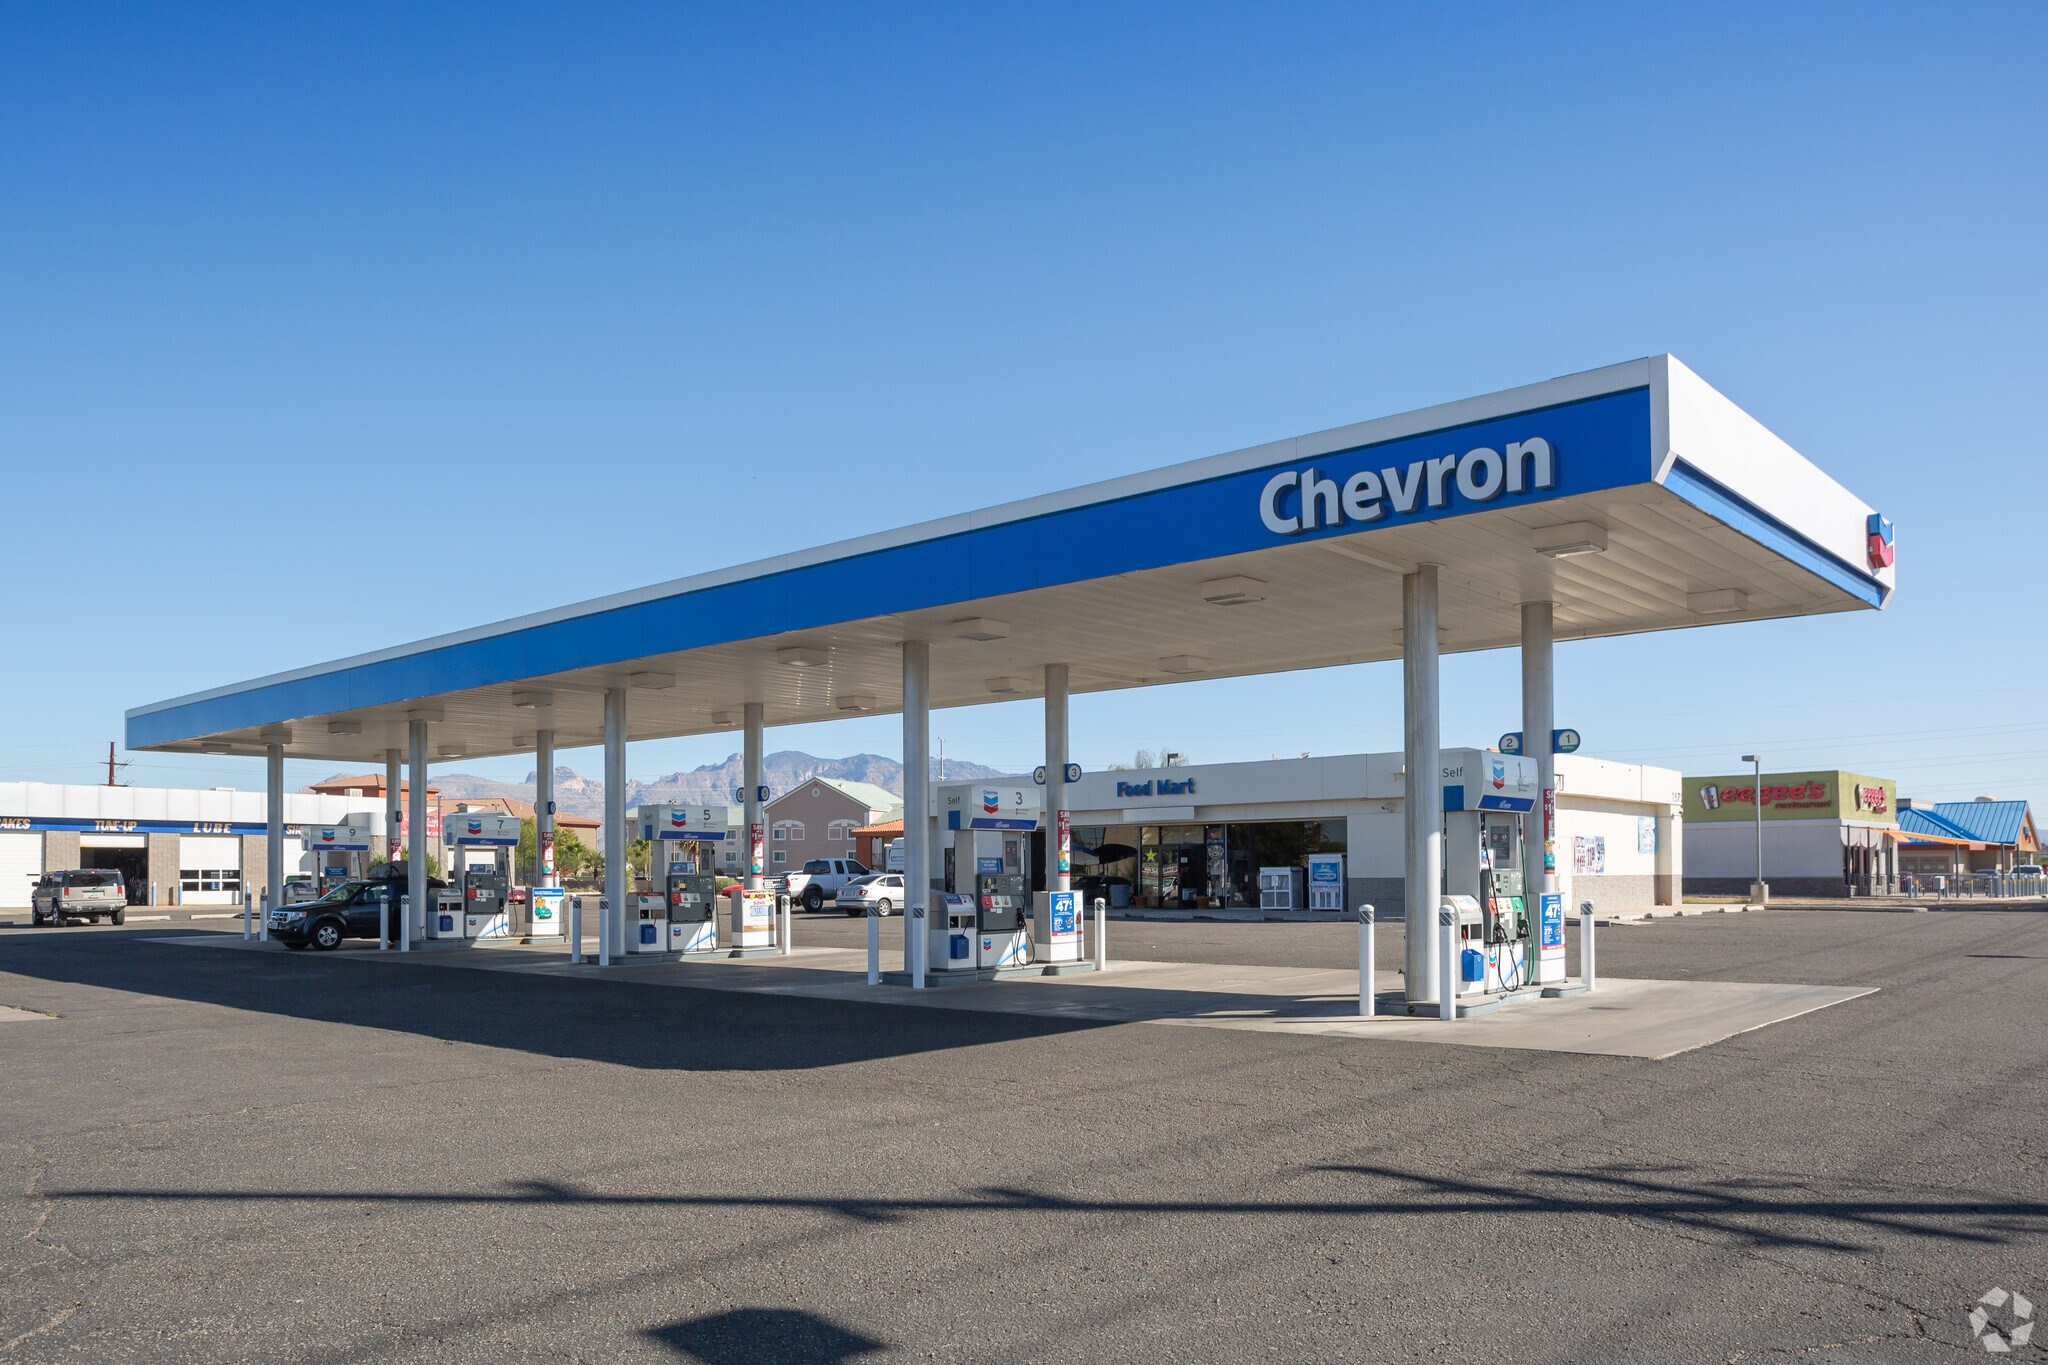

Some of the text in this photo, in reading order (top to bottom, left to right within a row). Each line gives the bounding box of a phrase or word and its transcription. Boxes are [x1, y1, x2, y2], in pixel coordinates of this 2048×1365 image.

[1259, 437, 1554, 534] Chevron
[1506, 738, 1513, 748] 2
[1565, 734, 1571, 744] 1
[1037, 771, 1043, 780] 4
[1071, 768, 1077, 778] 3
[1442, 766, 1464, 778] Self
[1116, 777, 1195, 797] Food Mart
[739, 790, 744, 799] 6
[763, 789, 768, 798] 5
[1015, 791, 1023, 805] 3
[1720, 780, 1825, 807] eegee's
[947, 796, 960, 805] Self
[703, 809, 711, 821] 5
[0, 818, 31, 830] AKES
[95, 820, 138, 832] TUNE-UP
[193, 822, 232, 834] LUBE
[497, 820, 504, 829] 7
[349, 828, 356, 837] 9
